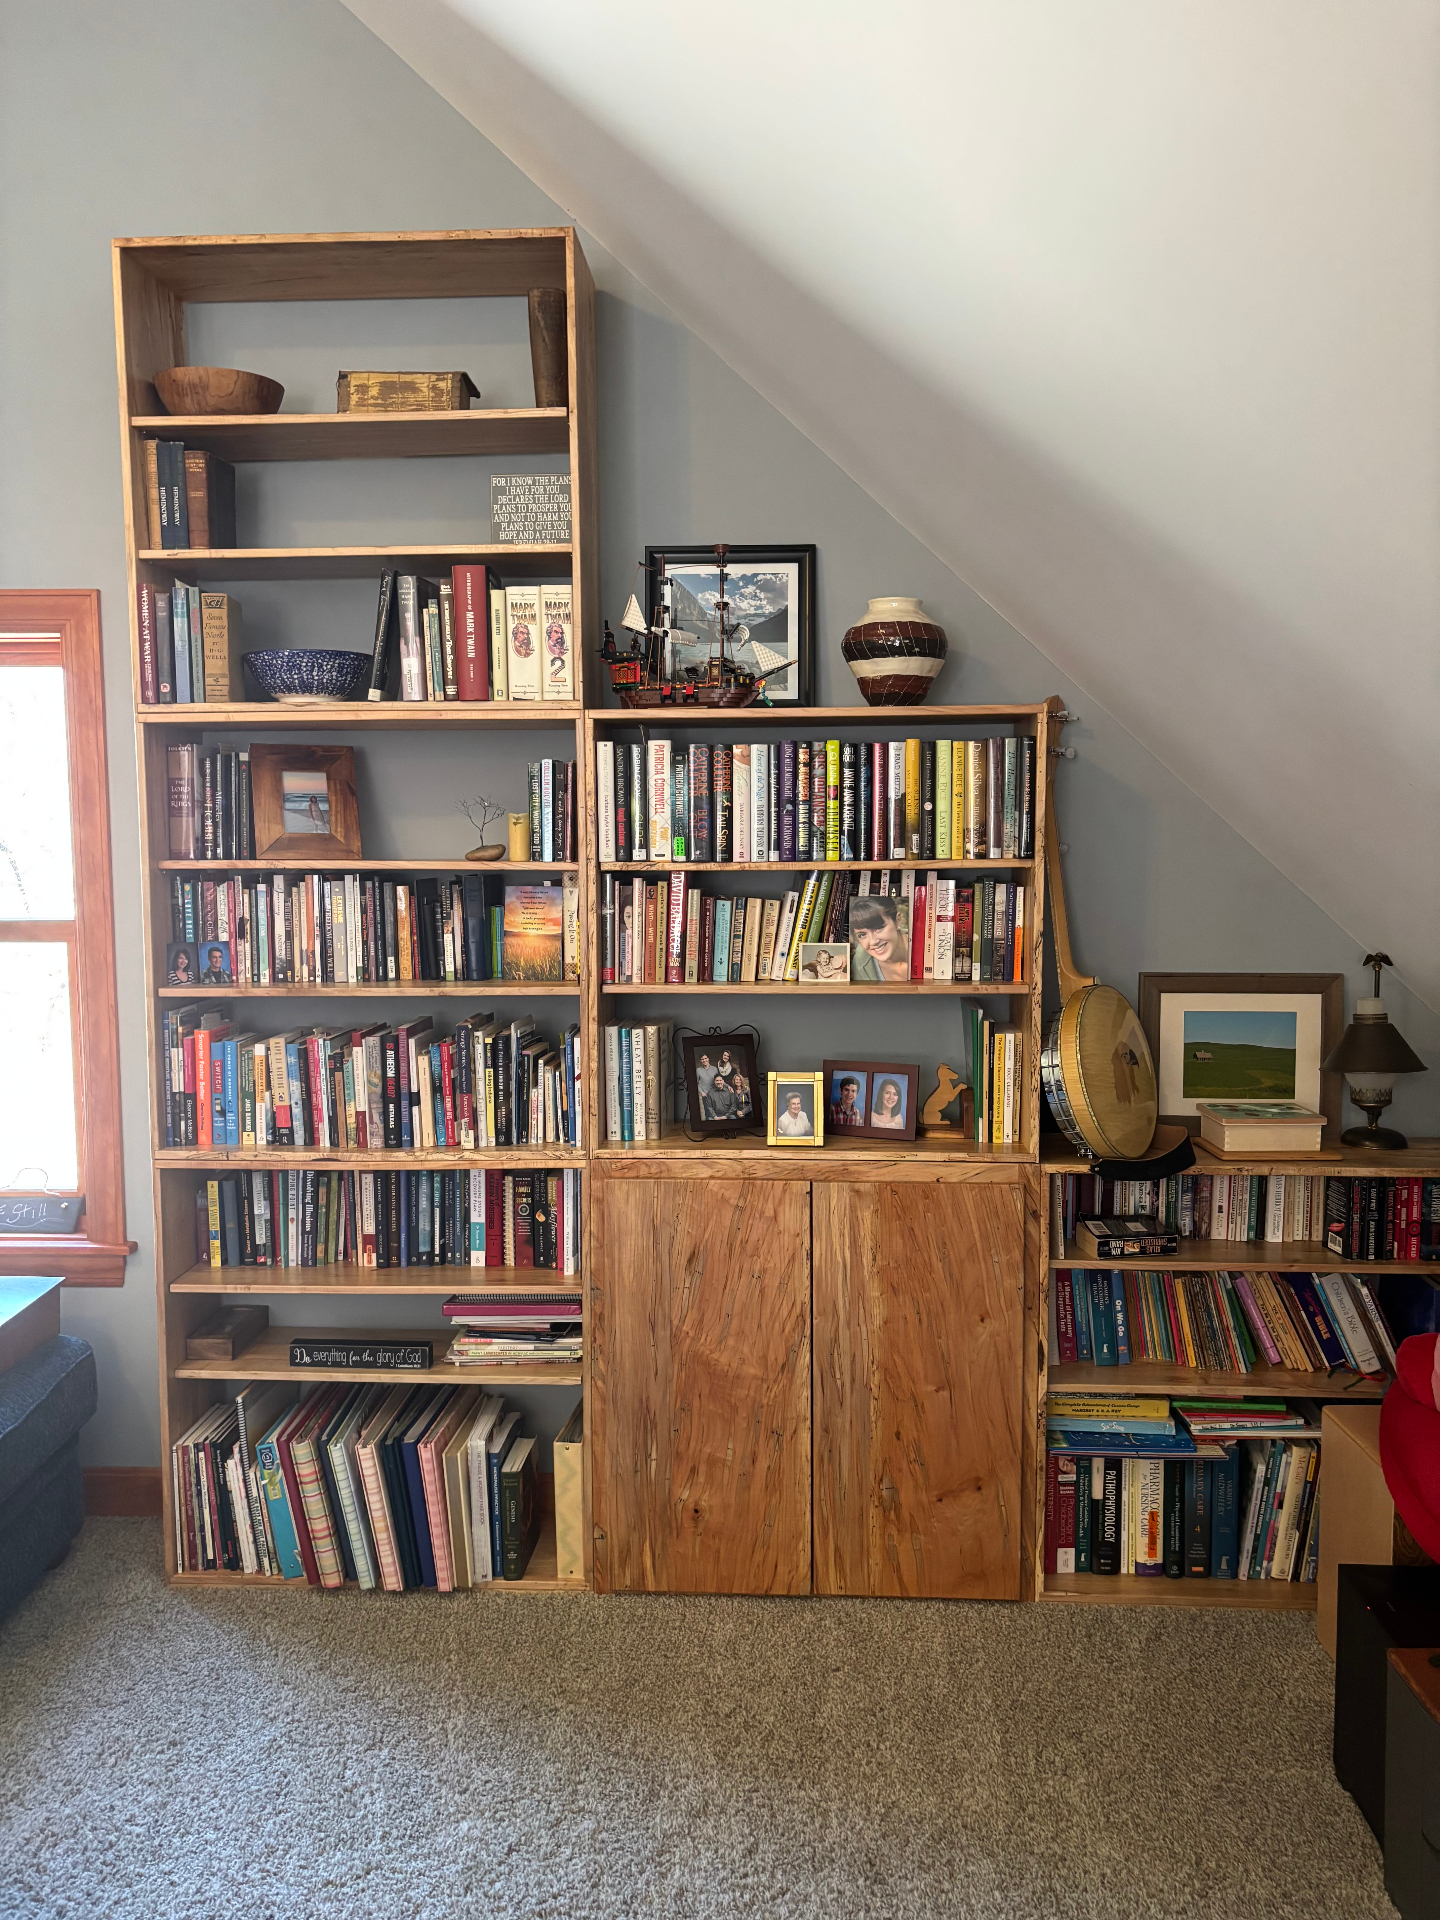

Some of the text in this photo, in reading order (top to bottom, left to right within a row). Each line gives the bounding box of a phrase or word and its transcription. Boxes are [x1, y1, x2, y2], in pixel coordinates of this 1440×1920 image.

[492, 477, 550, 486] FOR I KNOW THE
[506, 485, 560, 495] I HAVE FOR YOU
[493, 504, 558, 513] PLANS TO PROSPER
[498, 494, 569, 504] DECLARES THE LORD
[494, 513, 558, 522] AND NOT TO HARM
[501, 521, 567, 531] PLANS TO GIVE YOU
[499, 530, 570, 540] HOPE AND A FUTURE
[141, 589, 150, 627] WOMEN
[510, 602, 536, 614] MARK
[511, 613, 537, 625] TWAIN
[544, 601, 570, 612] MARK
[545, 612, 572, 624] TWAIN
[143, 628, 151, 640] AT
[466, 612, 475, 658] MARK TWAIN
[616, 748, 624, 777] SANDRA
[784, 744, 793, 758] LONG
[973, 743, 982, 772] Daniel
[654, 744, 666, 815] PATRICIA CORNWELL
[675, 764, 684, 788] PATRICIA
[697, 748, 709, 797] CATHERINE
[713, 751, 722, 792] COULTER
[722, 750, 731, 792] CATHERINE
[531, 779, 539, 792] LOST
[617, 778, 625, 804] BROWN
[812, 750, 826, 827] IRIS JOHANSEN
[939, 744, 948, 848] LUANNE RICE LAST KISS
[973, 773, 982, 795] Silva
[842, 768, 855, 830] JAYNE ANN KRENTZ
[616, 808, 626, 822] tough
[798, 804, 809, 851] DARK SUMMER
[827, 805, 839, 852] JOHANSEN
[671, 873, 683, 904] DAVID
[938, 888, 949, 913] THOR
[184, 899, 192, 917] LOVE
[800, 908, 811, 930] THOR
[937, 934, 945, 960] UNION
[634, 1032, 642, 1065] WHEAT
[386, 1049, 395, 1077] ATHEISM
[386, 1077, 395, 1098] DEAD?
[623, 1096, 631, 1111] DIET
[6, 1202, 47, 1224] Still
[305, 1170, 315, 1231] Dissolving Illusions
[549, 1202, 558, 1243] Mayflower
[1115, 1299, 1125, 1337] On We Go
[313, 1348, 347, 1365] everything
[376, 1349, 395, 1367] glory
[396, 1348, 405, 1363] of
[405, 1348, 422, 1363] God
[1104, 1470, 1117, 1543] PATHOPHYSIOLOGY
[1196, 1493, 1204, 1516] CARE
[1217, 1472, 1226, 1517] MIDWIFERY
[510, 1500, 518, 1523] GENESIS
[1059, 1498, 1068, 1544] Childbearing
[1066, 1498, 1075, 1534] Physiology
[1140, 1482, 1149, 1538] NURSING CARE
